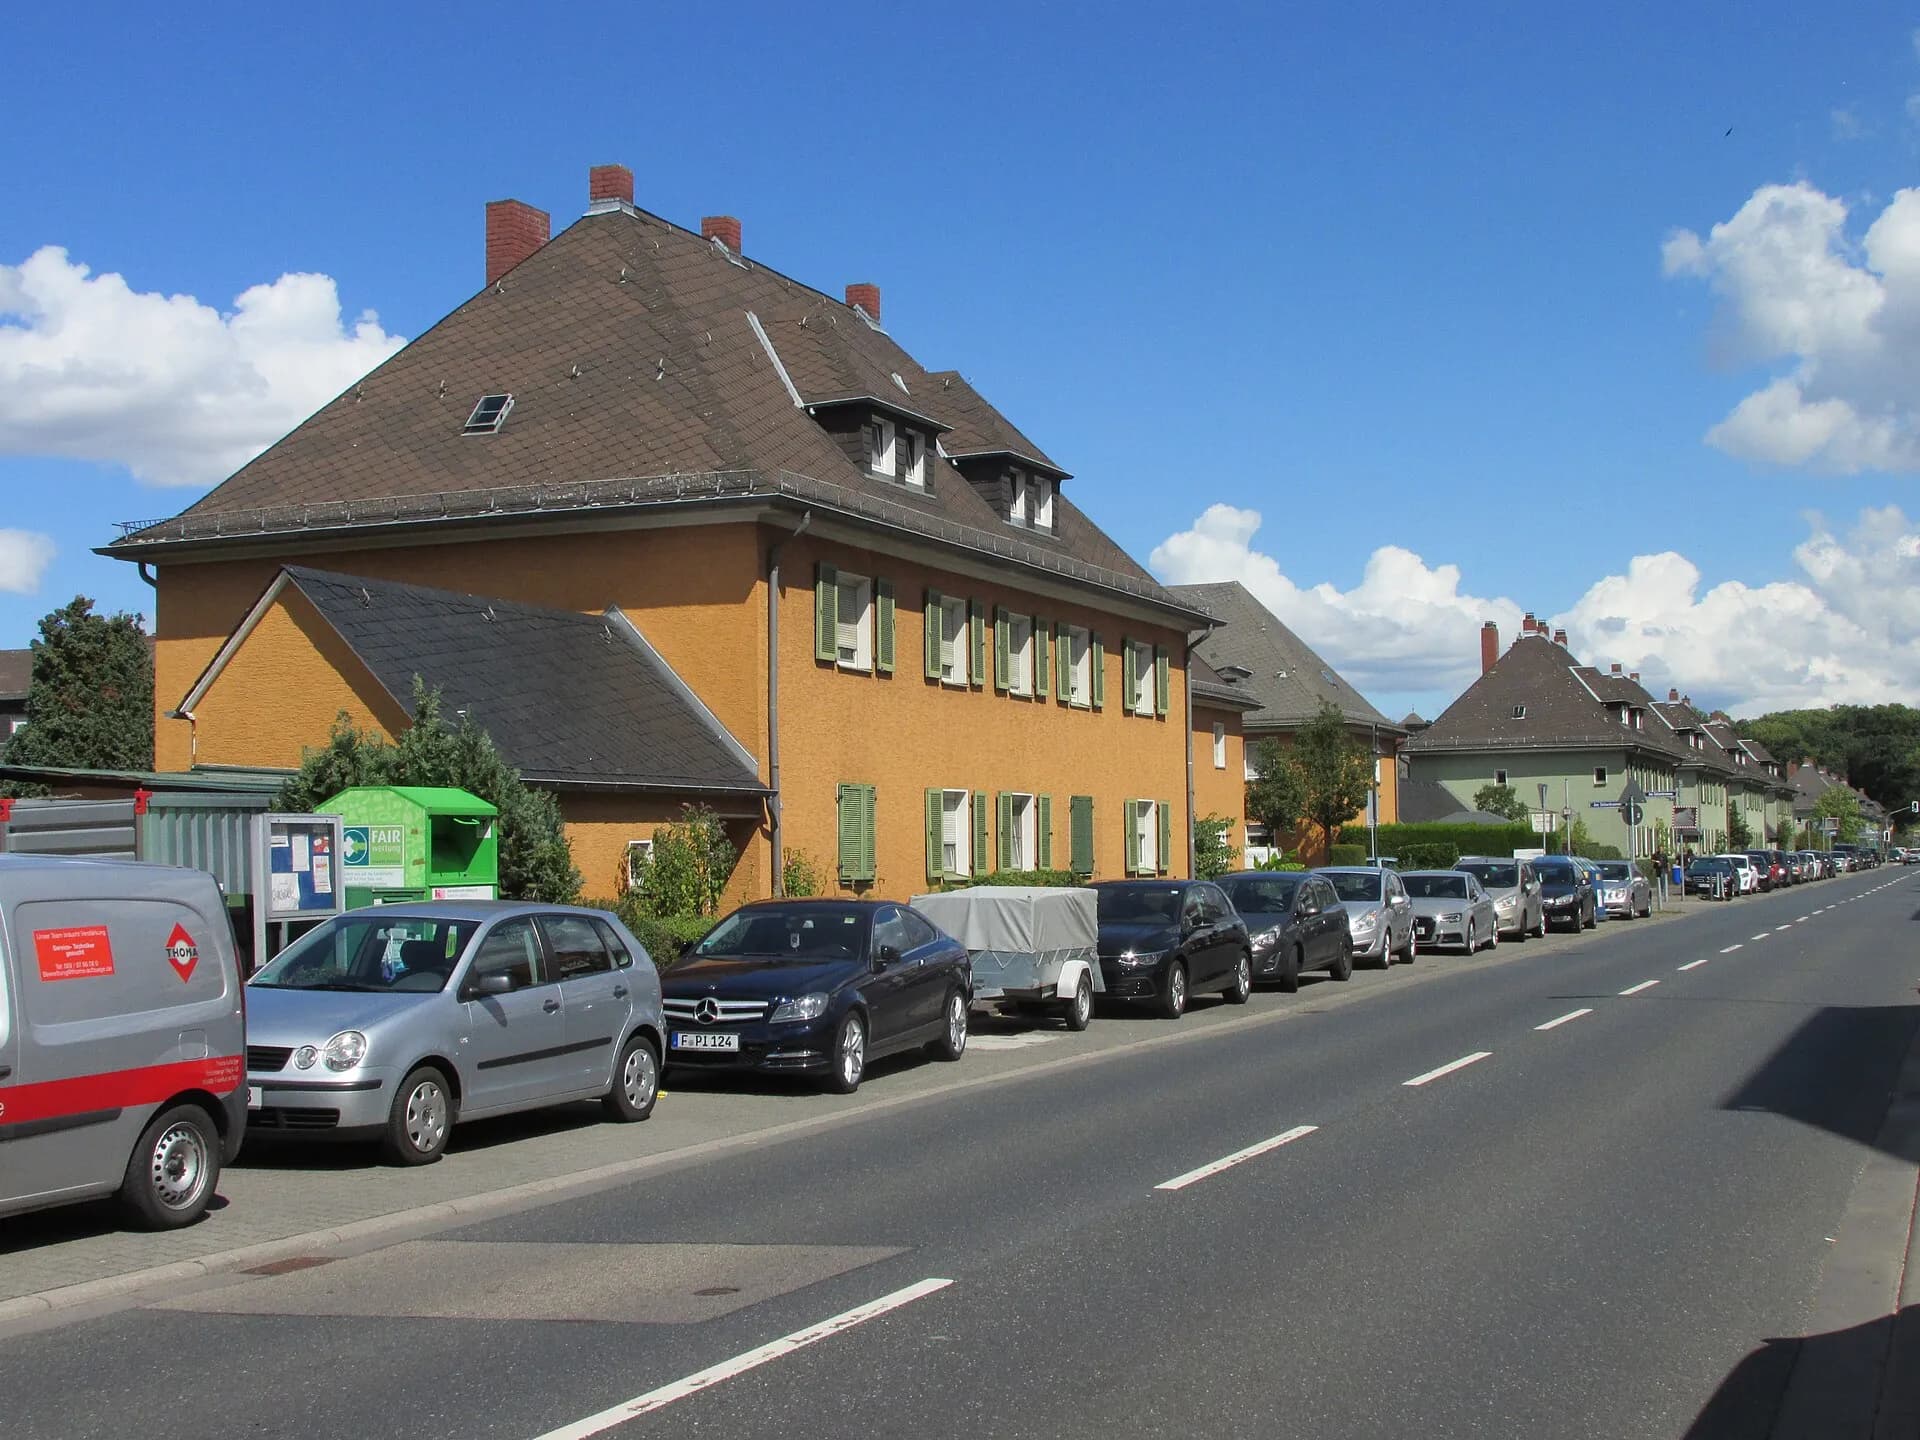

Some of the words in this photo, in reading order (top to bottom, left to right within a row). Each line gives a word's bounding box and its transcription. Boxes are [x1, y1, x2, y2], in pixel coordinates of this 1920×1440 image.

[371, 829, 401, 843] FAIR
[165, 947, 199, 958] THOMA
[681, 1034, 688, 1046] F
[695, 1035, 708, 1047] PI
[711, 1035, 732, 1048] 124
